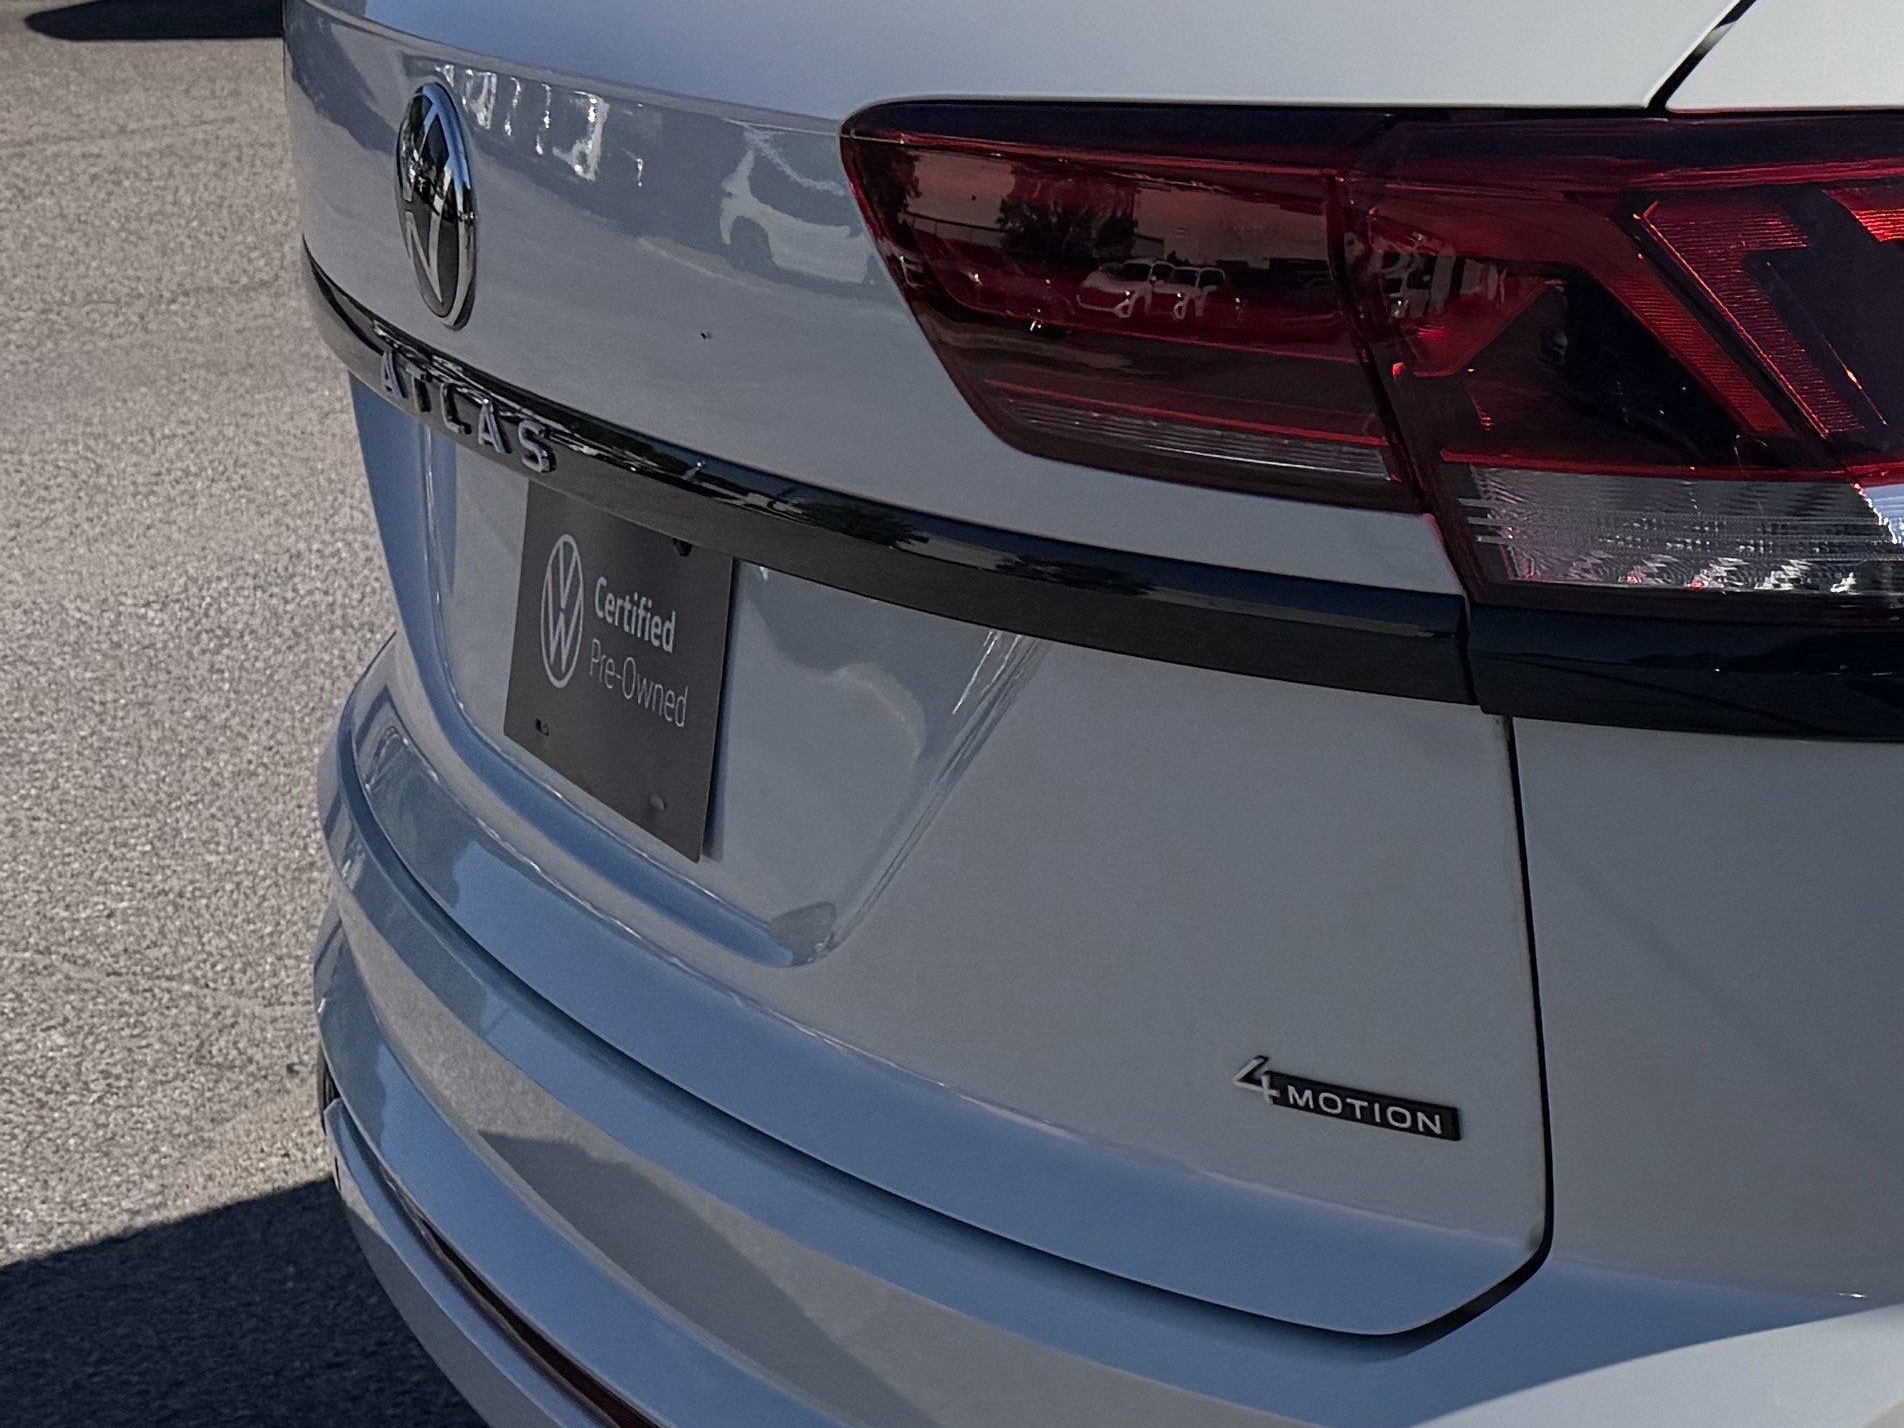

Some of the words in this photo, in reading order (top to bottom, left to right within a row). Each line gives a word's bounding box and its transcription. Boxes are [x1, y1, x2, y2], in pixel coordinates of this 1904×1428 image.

[382, 349, 558, 473] ATLAS
[594, 576, 677, 654] Certified
[588, 636, 689, 728] Pre-Owned
[1232, 1055, 1443, 1135] 4MOTION
